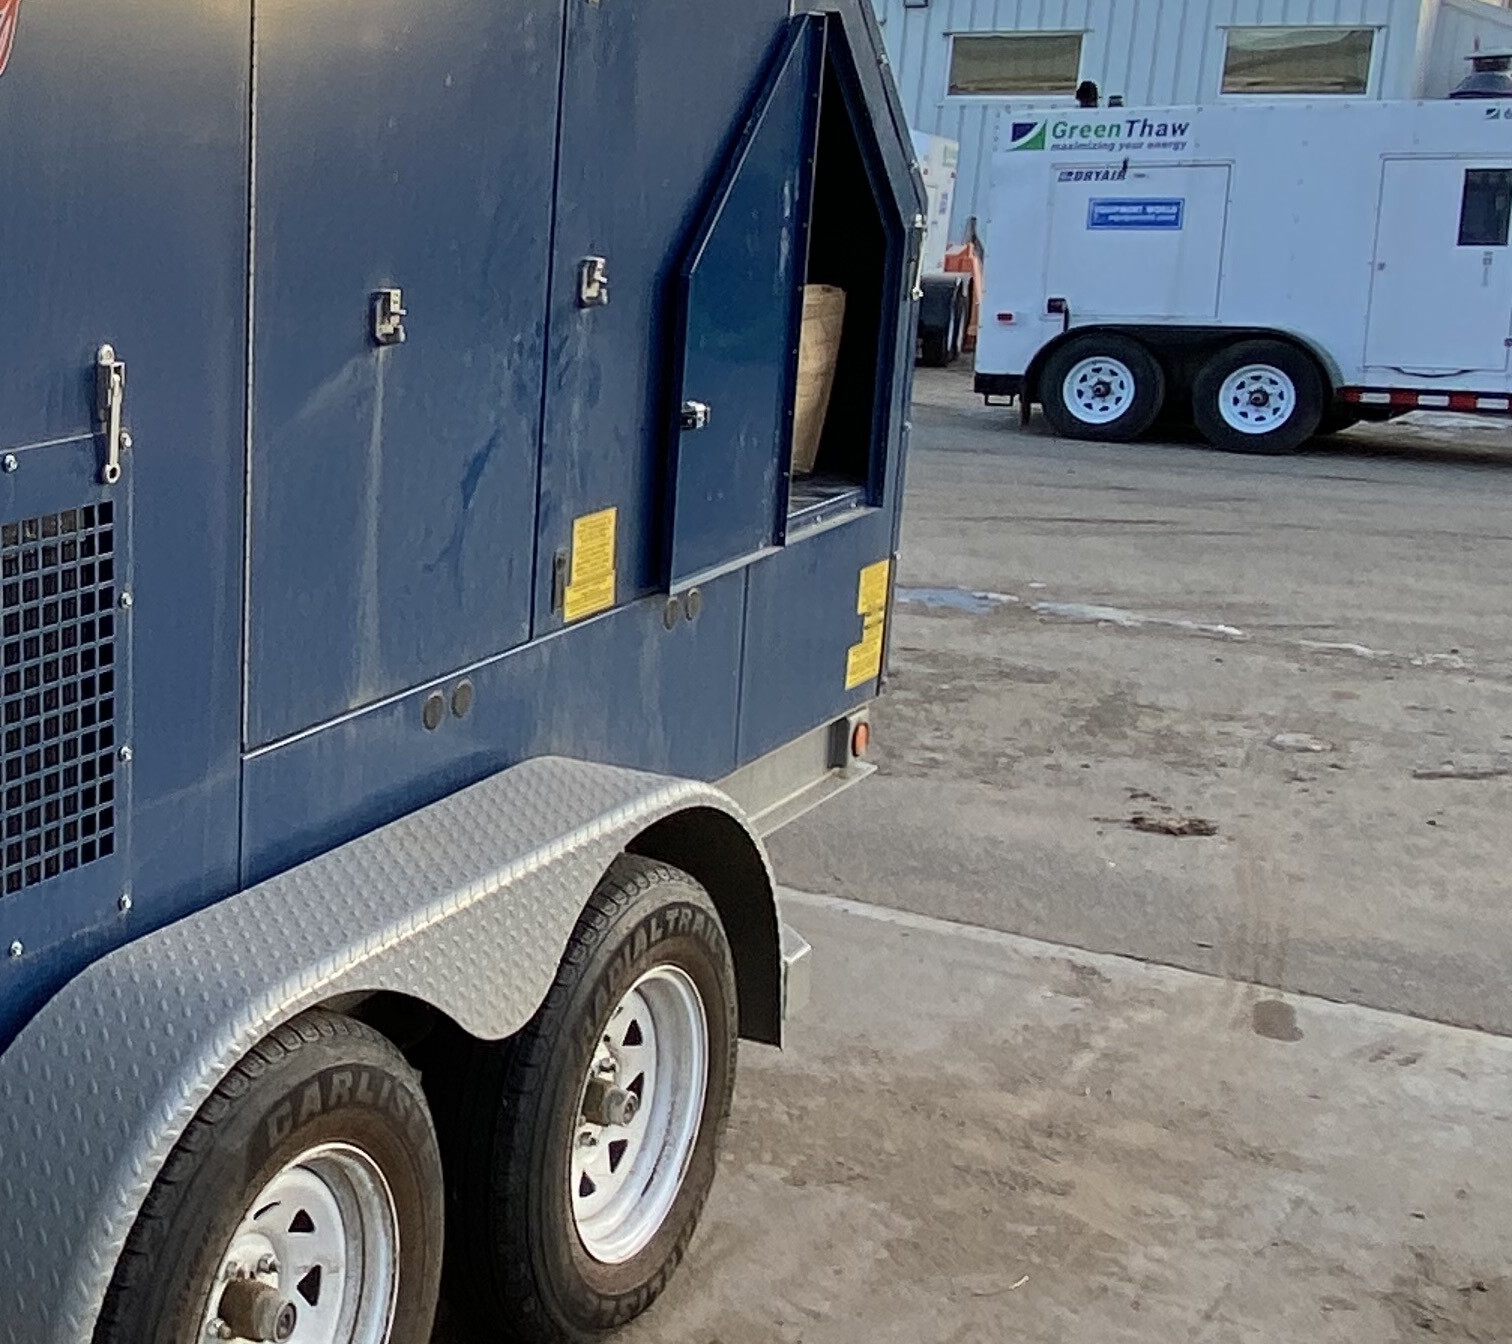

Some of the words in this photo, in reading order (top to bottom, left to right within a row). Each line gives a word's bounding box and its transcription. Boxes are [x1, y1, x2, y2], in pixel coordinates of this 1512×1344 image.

[1050, 141, 1116, 152] maximizing
[1118, 141, 1144, 152] your
[1146, 140, 1187, 151] energy
[1073, 169, 1127, 182] DRYAIR
